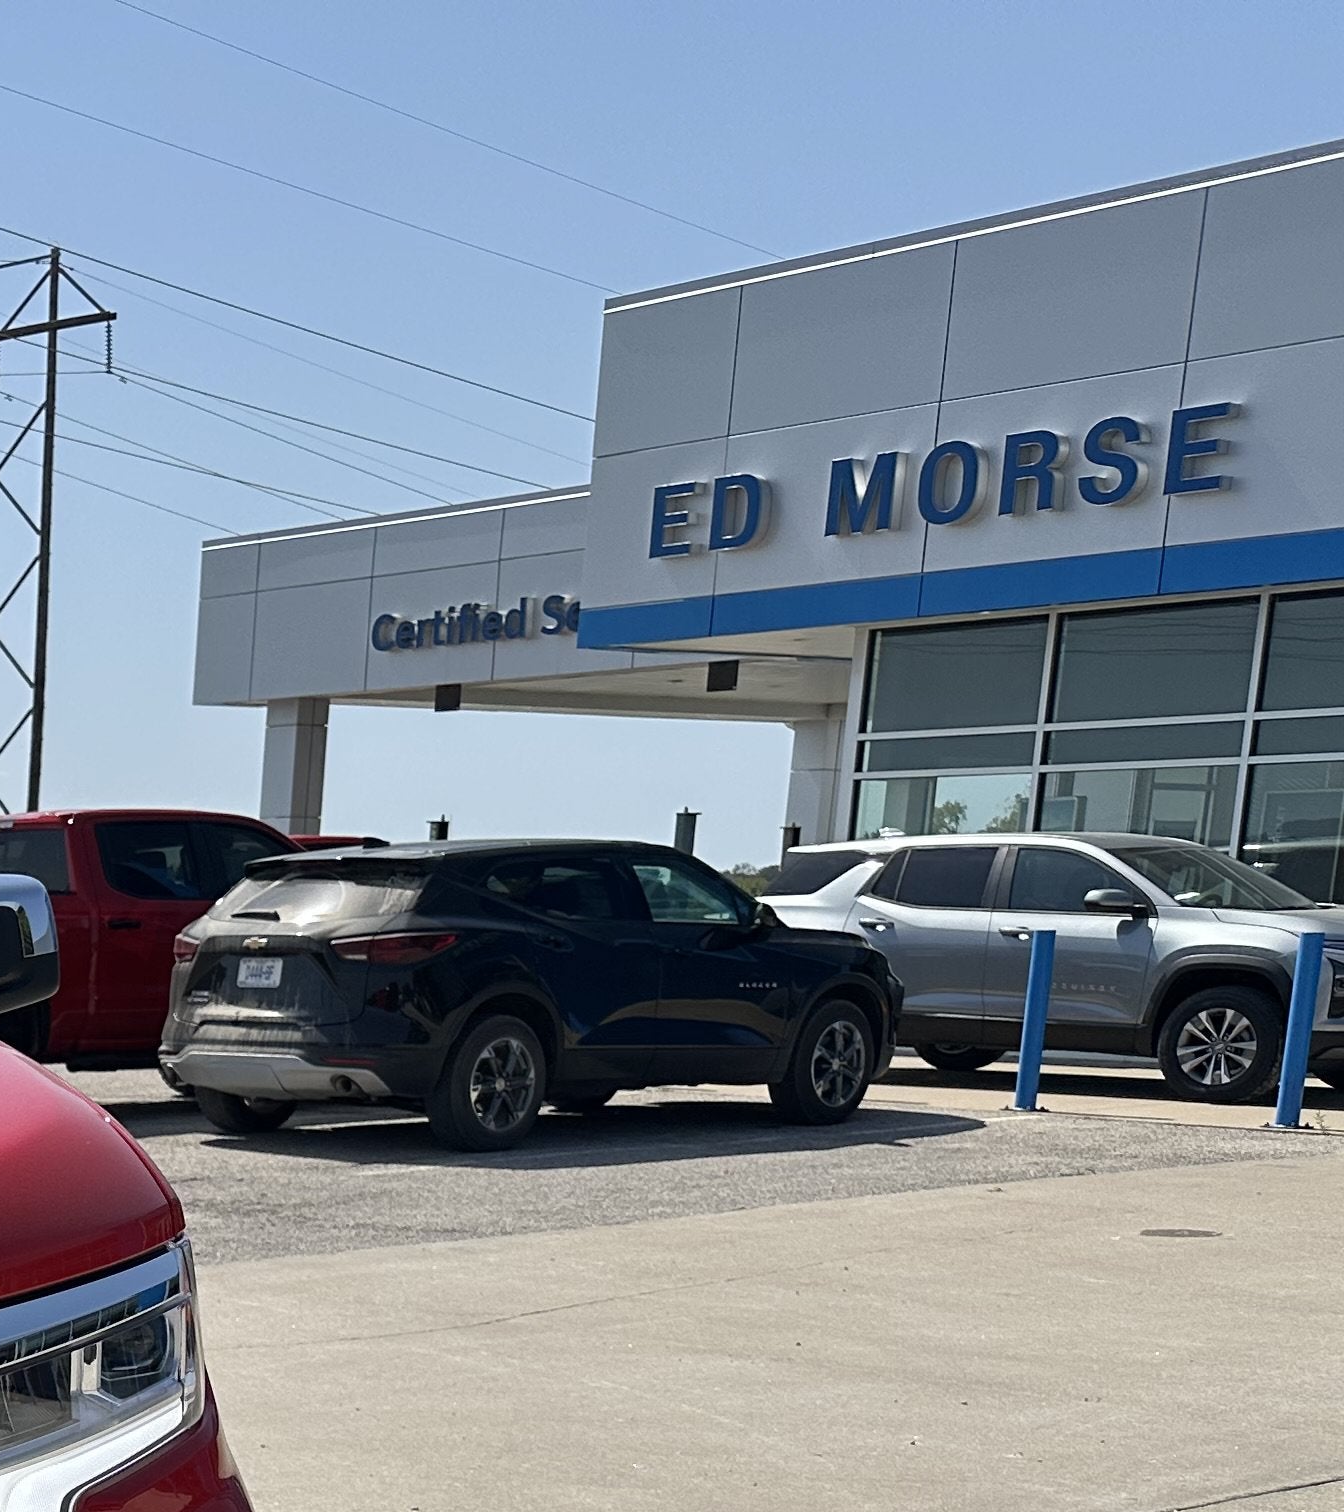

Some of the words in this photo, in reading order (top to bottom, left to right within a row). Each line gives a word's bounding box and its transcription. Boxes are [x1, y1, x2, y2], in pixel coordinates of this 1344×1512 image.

[649, 472, 770, 559] ED
[824, 401, 1242, 538] MORSE
[371, 597, 532, 652] Certified
